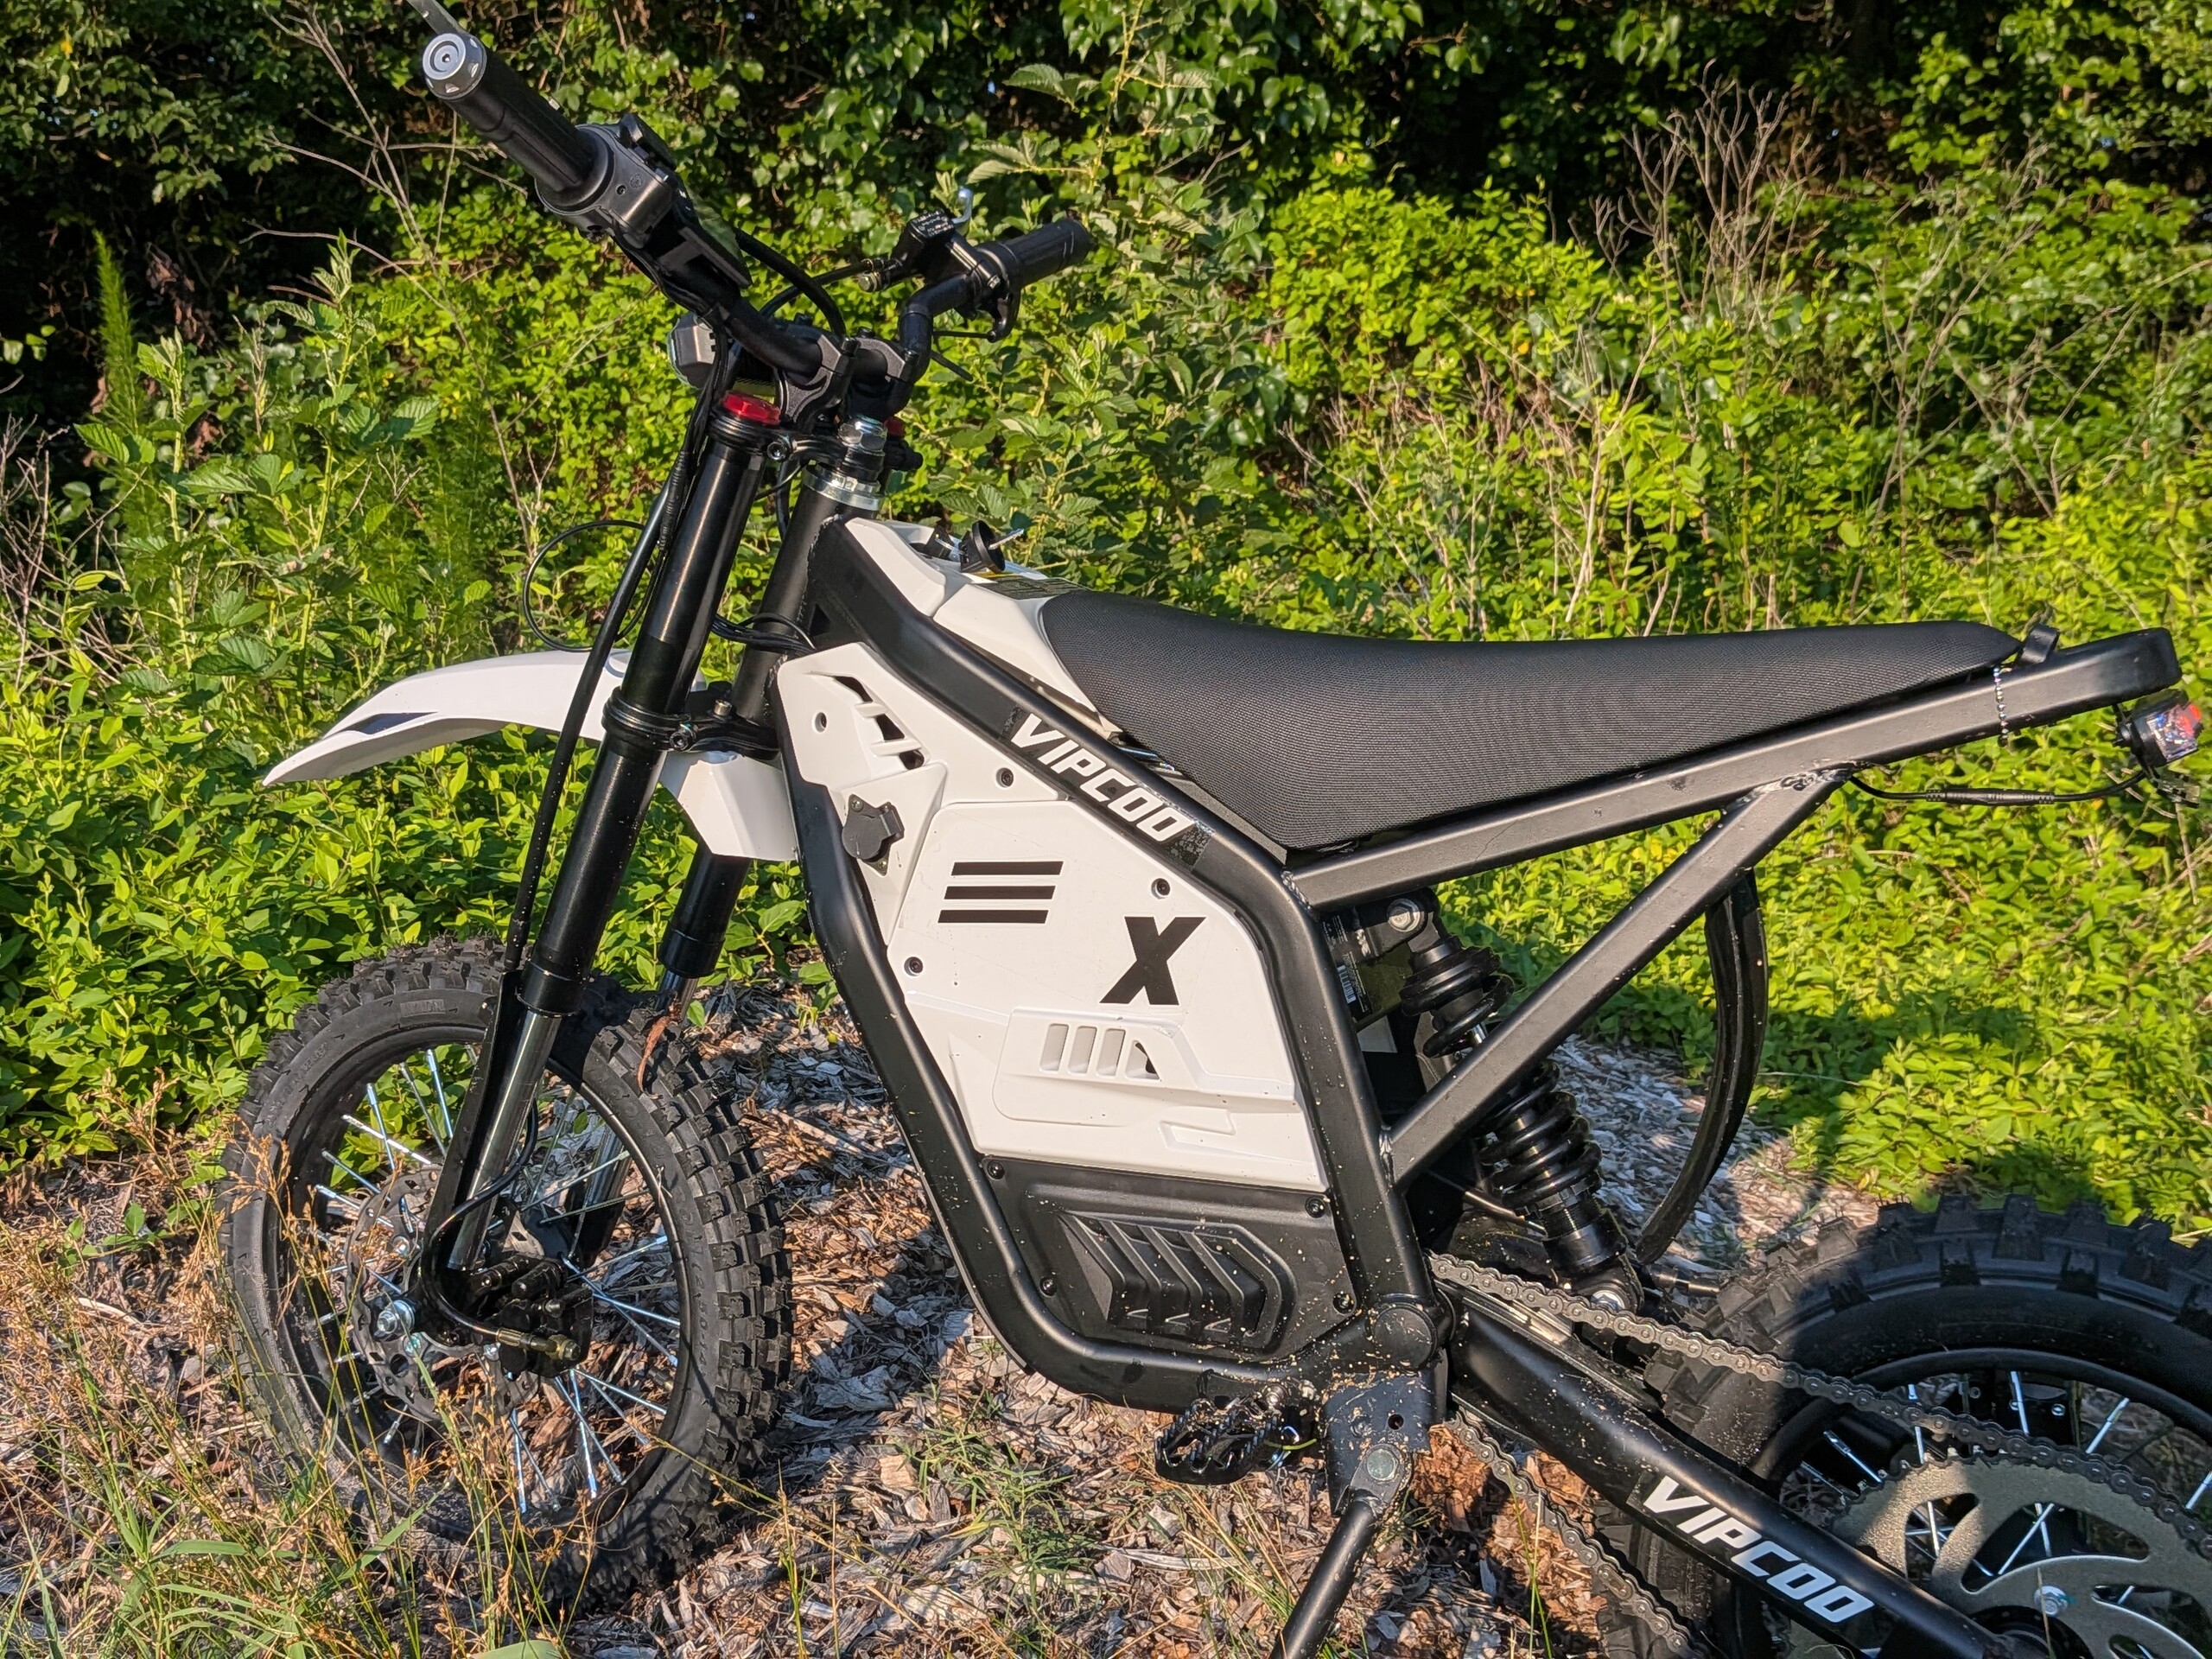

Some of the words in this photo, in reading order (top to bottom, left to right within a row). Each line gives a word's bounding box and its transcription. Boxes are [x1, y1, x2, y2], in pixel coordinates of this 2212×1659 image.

[1011, 714, 1195, 842] VIPCOO
[1099, 917, 1206, 1006] X
[1643, 1476, 1874, 1623] VIPCOO
